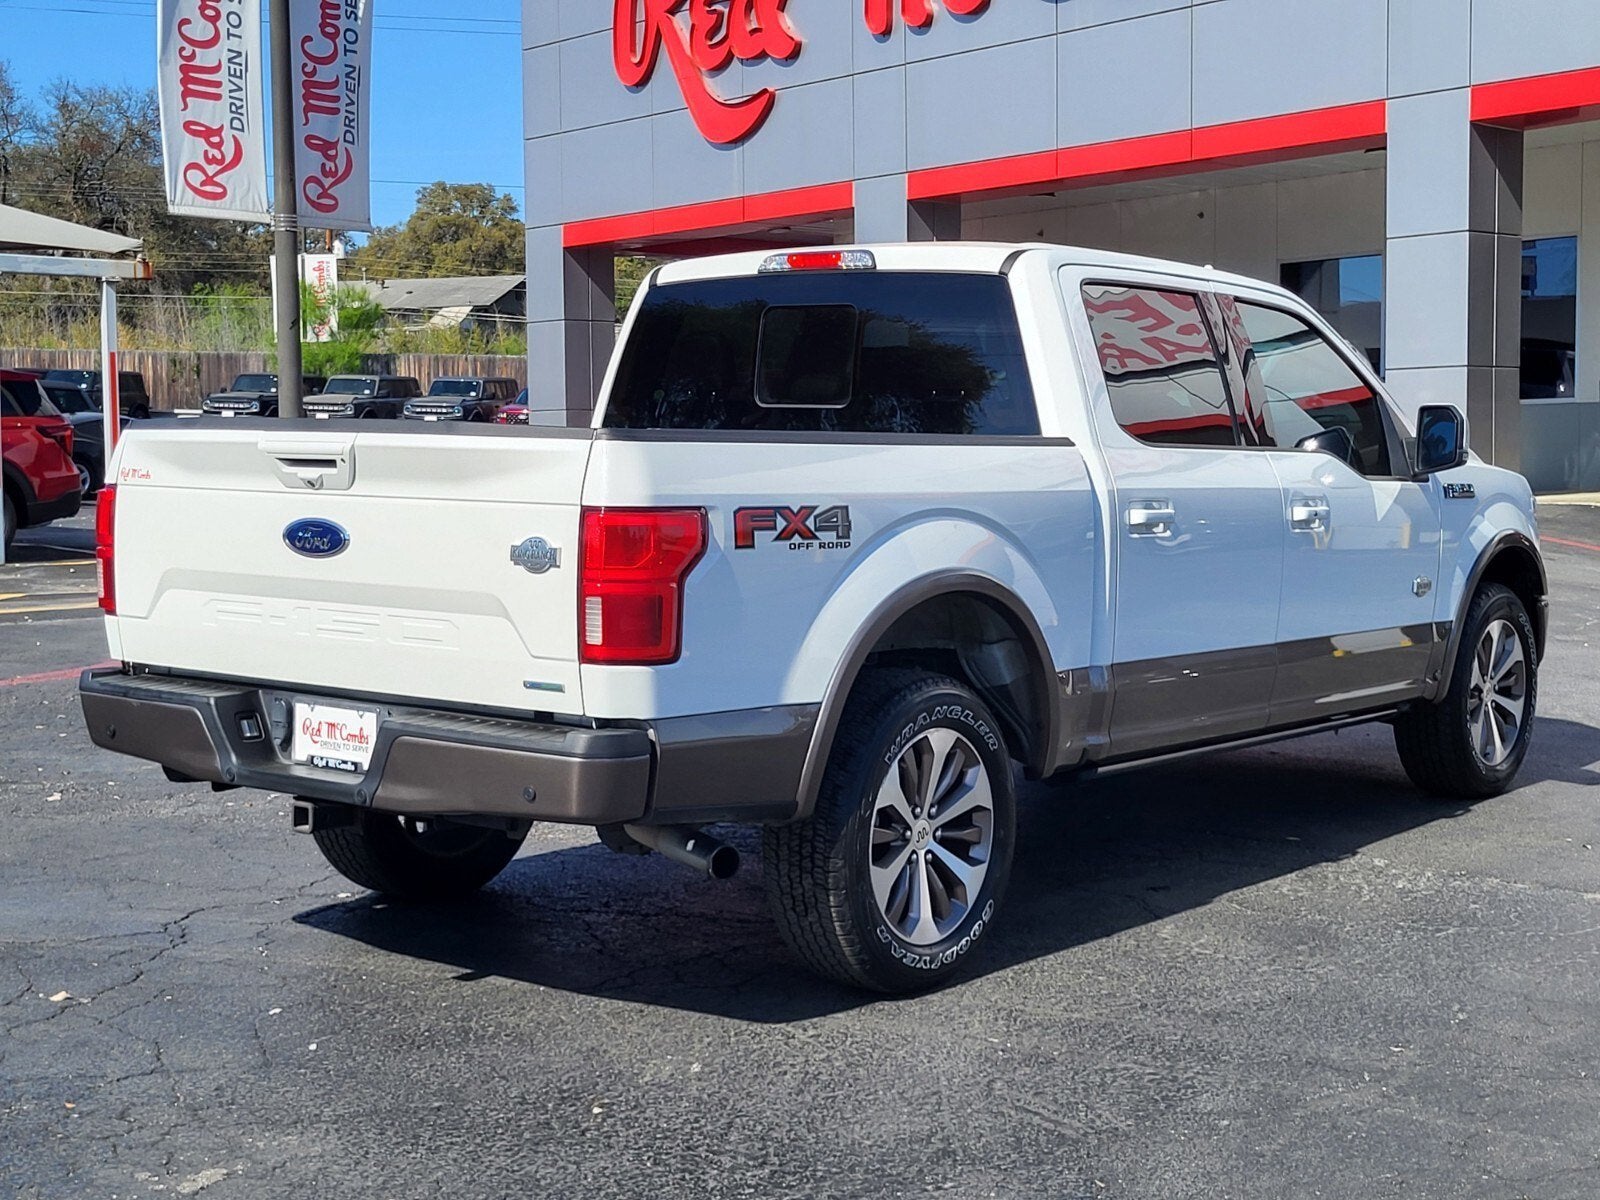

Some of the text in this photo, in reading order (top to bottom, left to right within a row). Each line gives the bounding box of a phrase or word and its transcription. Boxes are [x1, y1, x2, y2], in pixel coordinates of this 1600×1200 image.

[226, 10, 242, 41] TO
[342, 27, 358, 57] TO
[227, 48, 246, 133] DRIVEN
[342, 63, 357, 146] DRIVEN
[183, 120, 243, 201] Red
[303, 133, 353, 213] Red
[294, 526, 333, 551] Ford
[733, 505, 852, 550] FX4
[788, 541, 851, 551] OFF ROAD
[302, 717, 370, 746] Red McCombs
[319, 740, 370, 754] DRIVEN TO SERVE
[884, 705, 999, 765] WRANGLER
[877, 899, 995, 969] GOODYEAR
